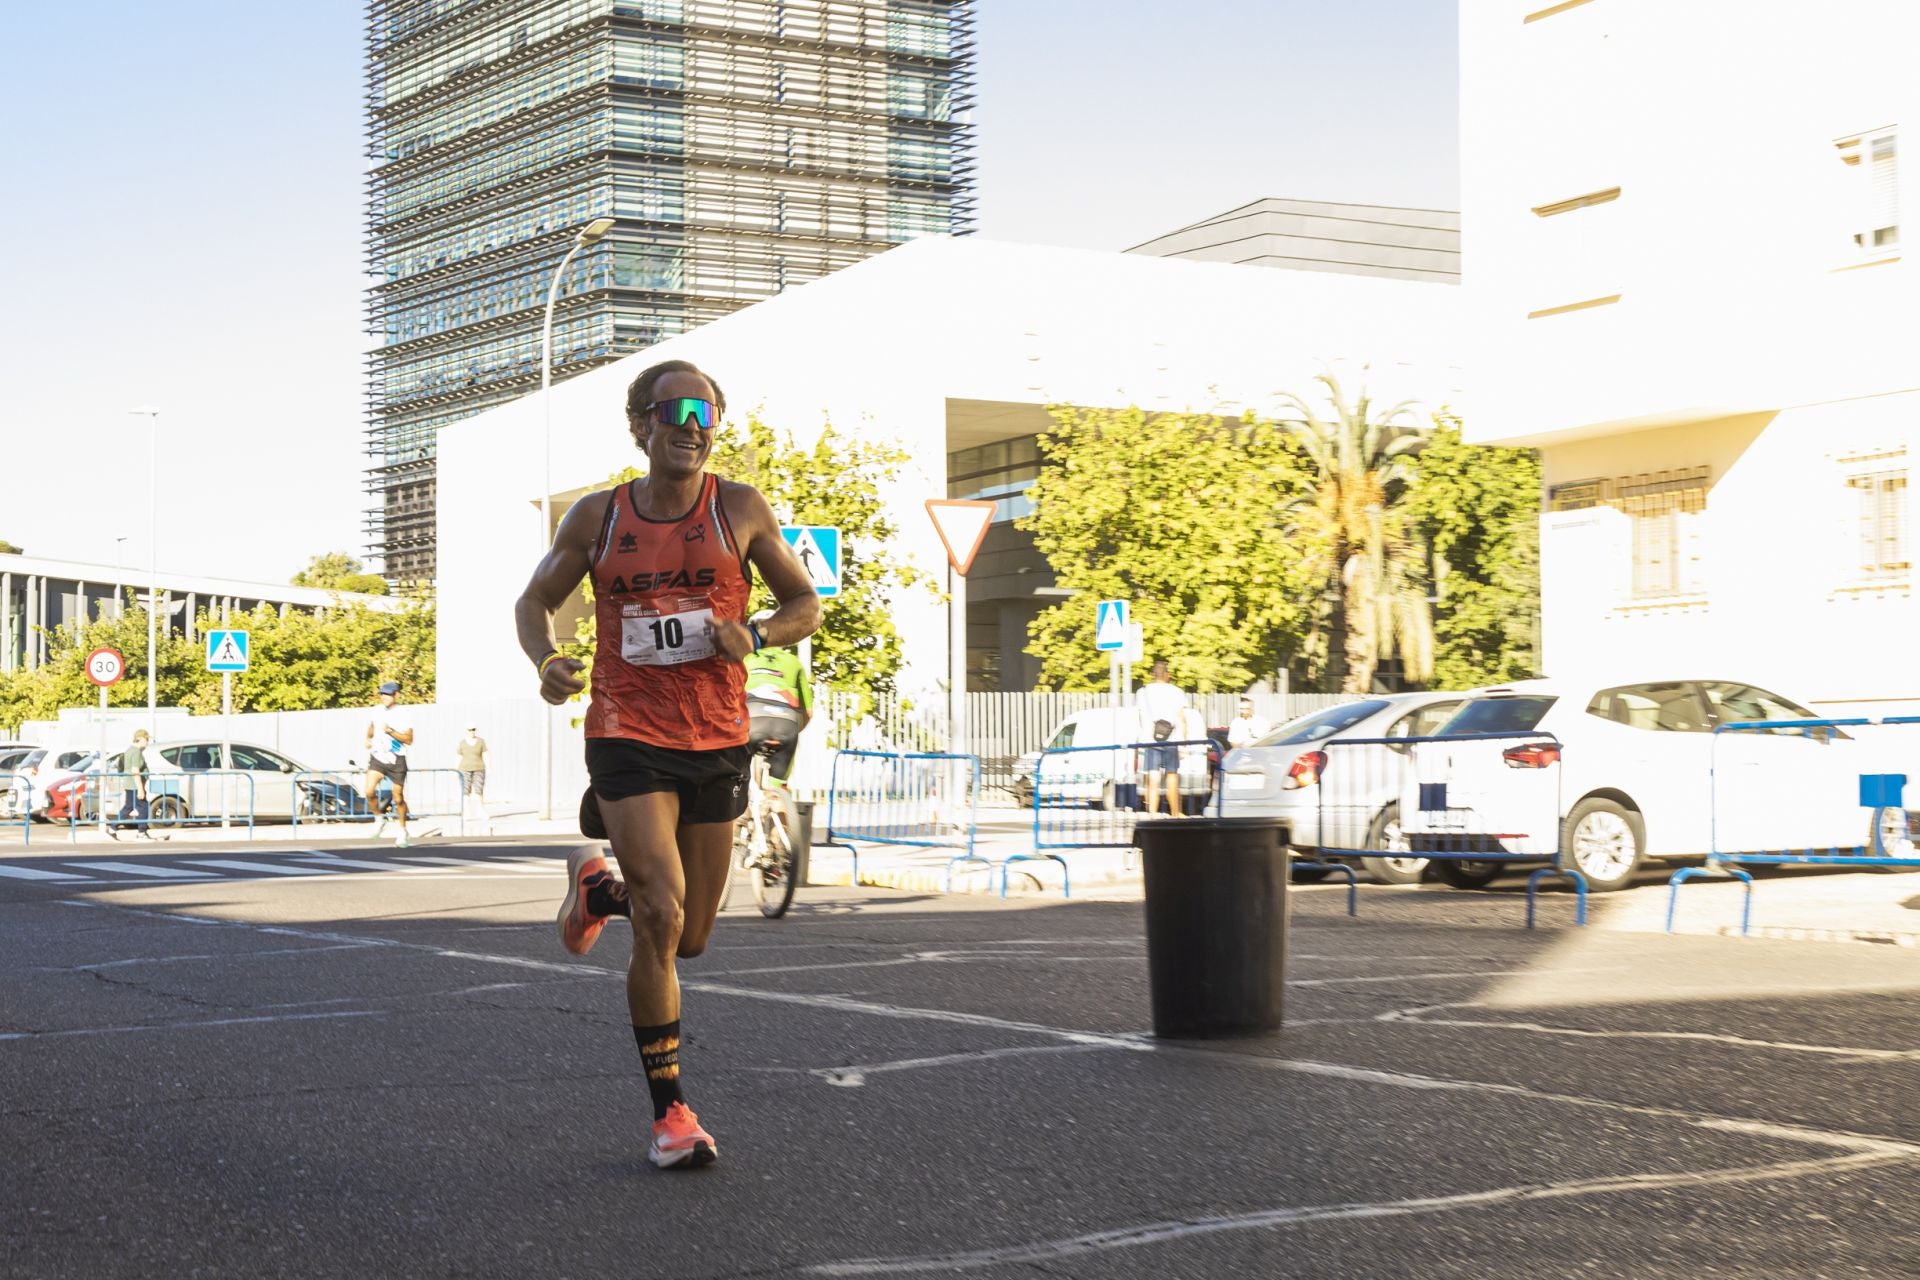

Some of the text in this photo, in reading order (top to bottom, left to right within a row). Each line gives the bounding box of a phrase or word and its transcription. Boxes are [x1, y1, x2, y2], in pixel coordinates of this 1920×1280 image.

[611, 568, 716, 593] ASFAS
[648, 617, 684, 650] 10
[95, 661, 115, 673] 30
